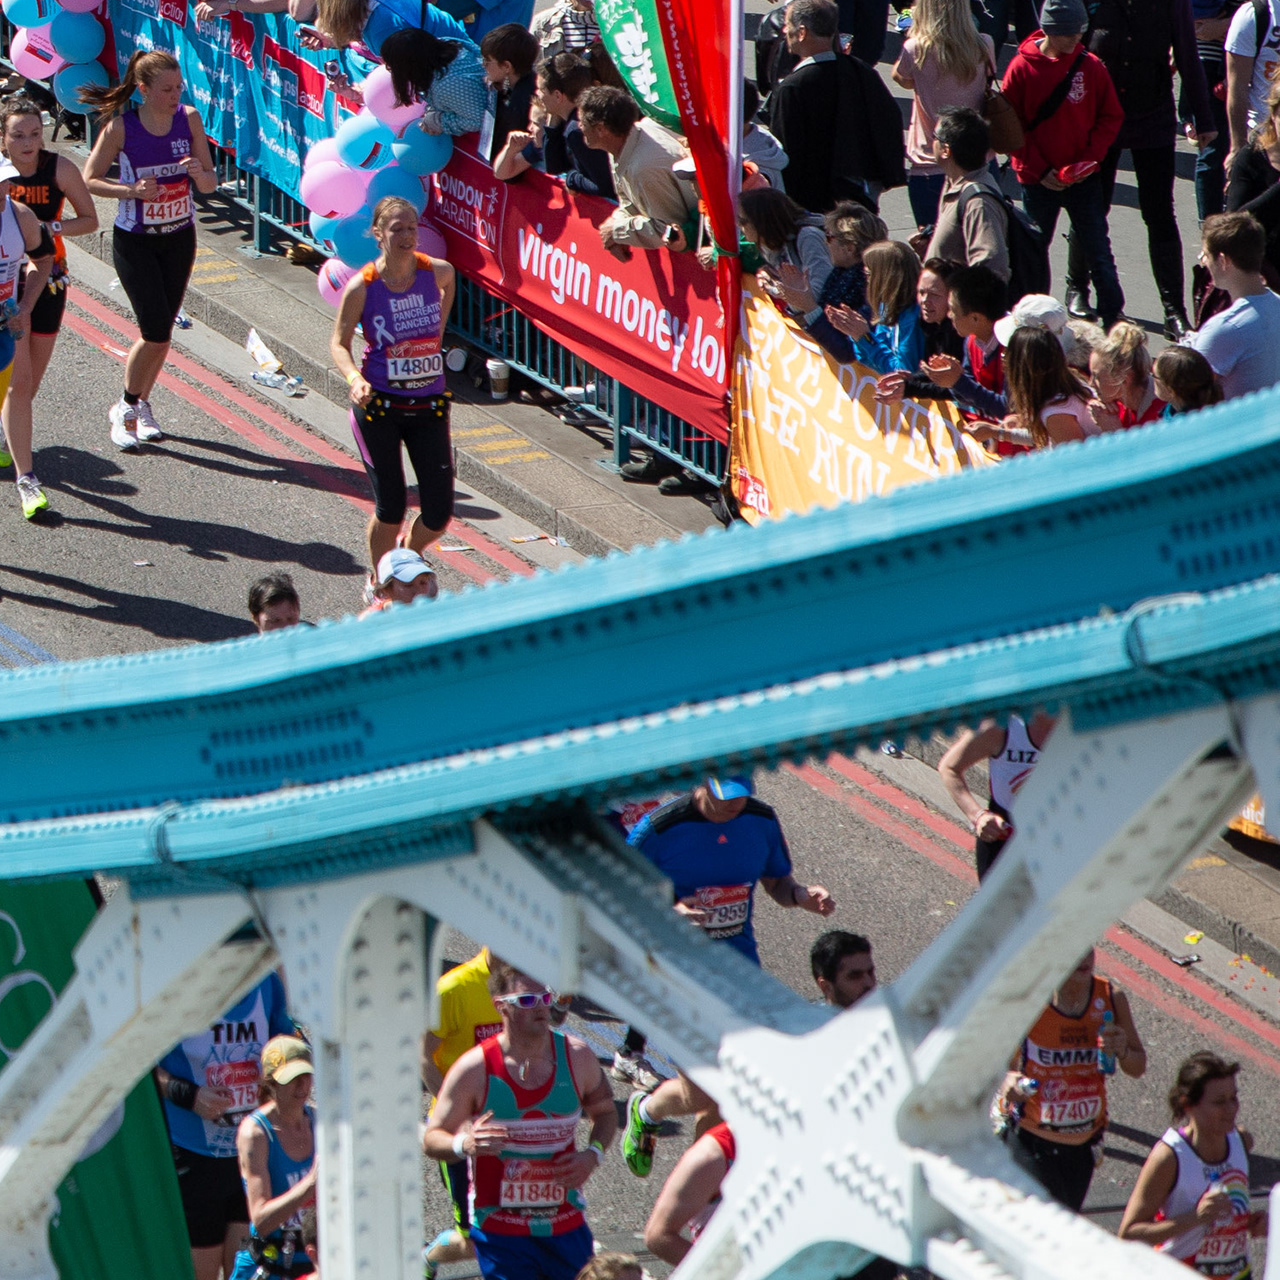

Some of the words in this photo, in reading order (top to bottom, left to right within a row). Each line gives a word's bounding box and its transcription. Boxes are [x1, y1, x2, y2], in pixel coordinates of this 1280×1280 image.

[299, 89, 324, 115] action
[170, 138, 190, 150] ndcs
[152, 164, 180, 177] LOU
[436, 173, 484, 207] LONDON
[146, 199, 190, 220] 44121
[434, 198, 497, 247] MARATHON
[389, 294, 425, 313] Emily
[519, 224, 591, 306] virgin
[596, 273, 688, 372] money
[393, 304, 442, 320] PANCREATIC
[394, 316, 428, 331] CANCER
[411, 342, 439, 355] money
[389, 357, 442, 380] 14800
[1006, 749, 1037, 764] LIZ
[210, 1021, 258, 1045] TIM
[1044, 1098, 1100, 1122] 47407
